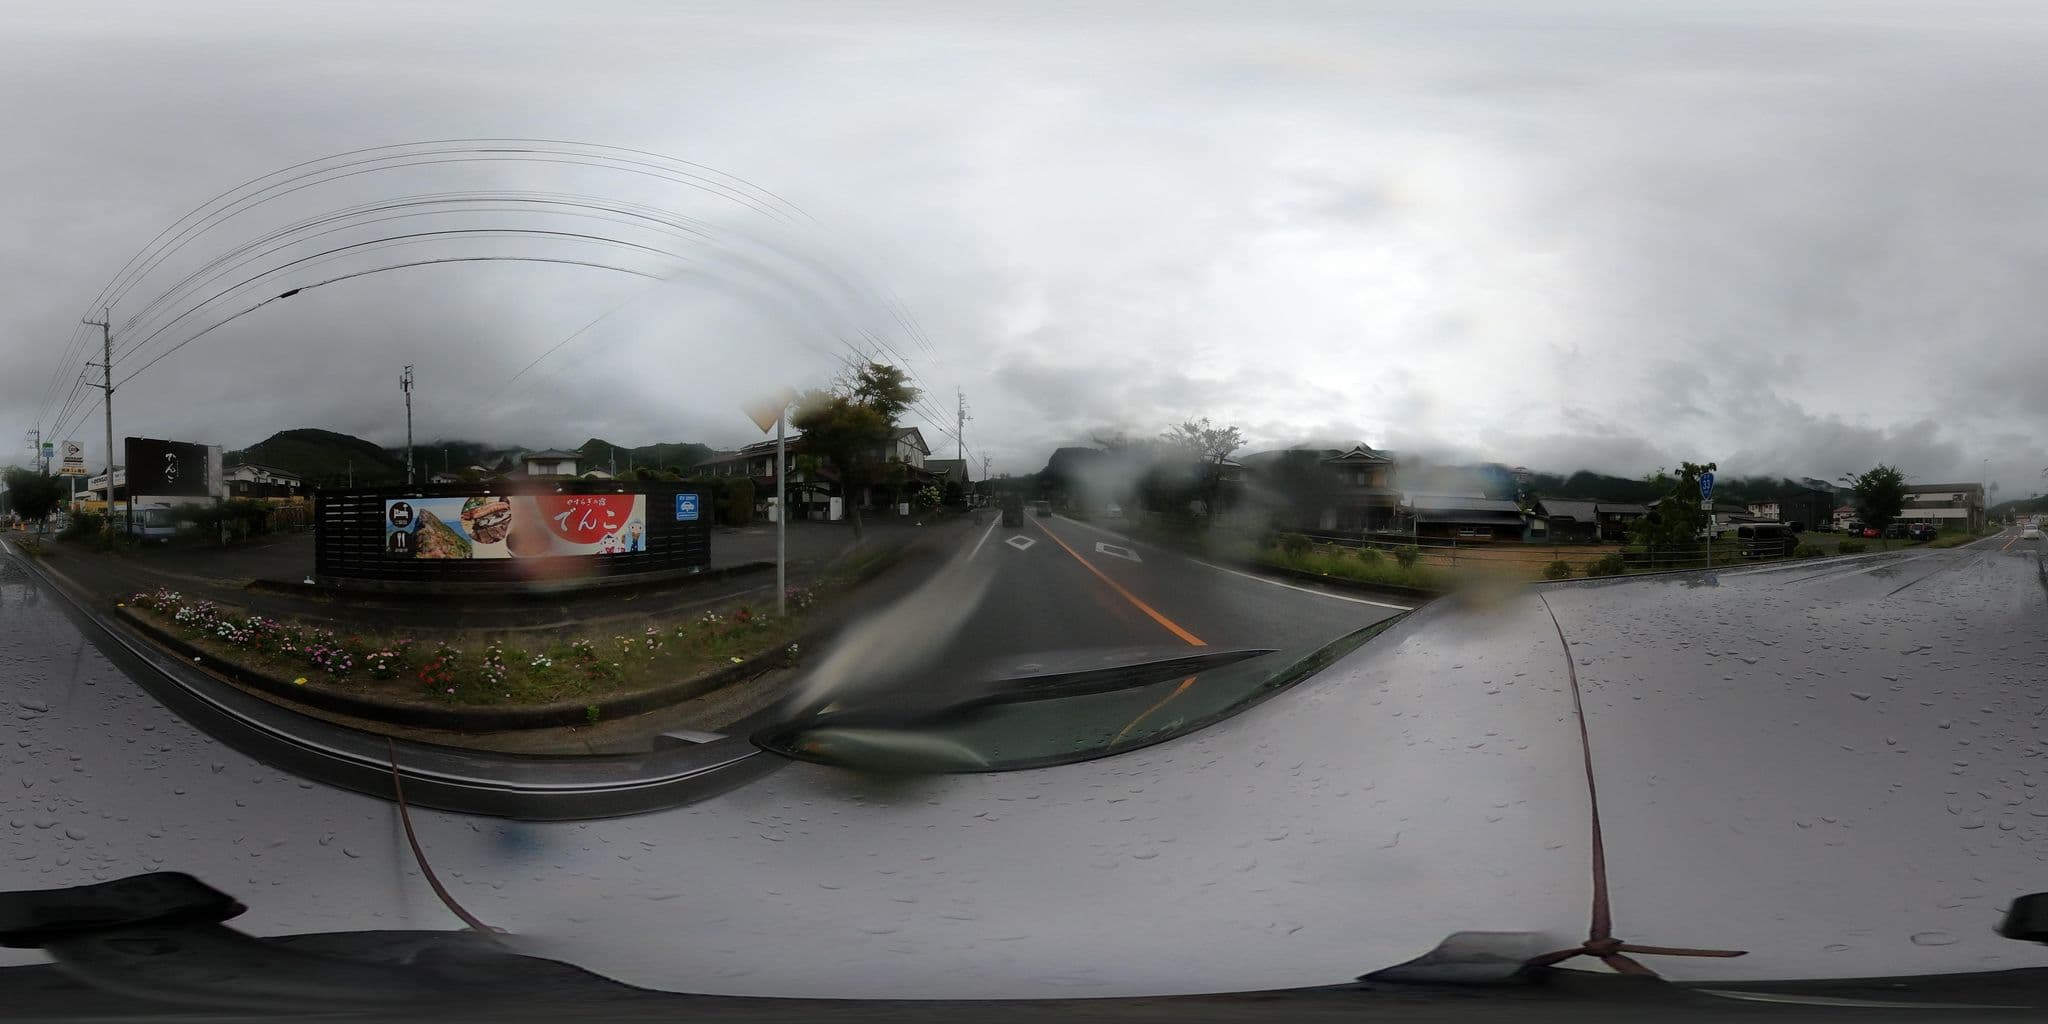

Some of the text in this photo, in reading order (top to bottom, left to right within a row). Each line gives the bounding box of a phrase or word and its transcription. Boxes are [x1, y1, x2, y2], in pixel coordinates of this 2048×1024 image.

[165, 452, 176, 484] でんこ
[1702, 479, 1711, 490] 33
[553, 507, 618, 532] でんこ
